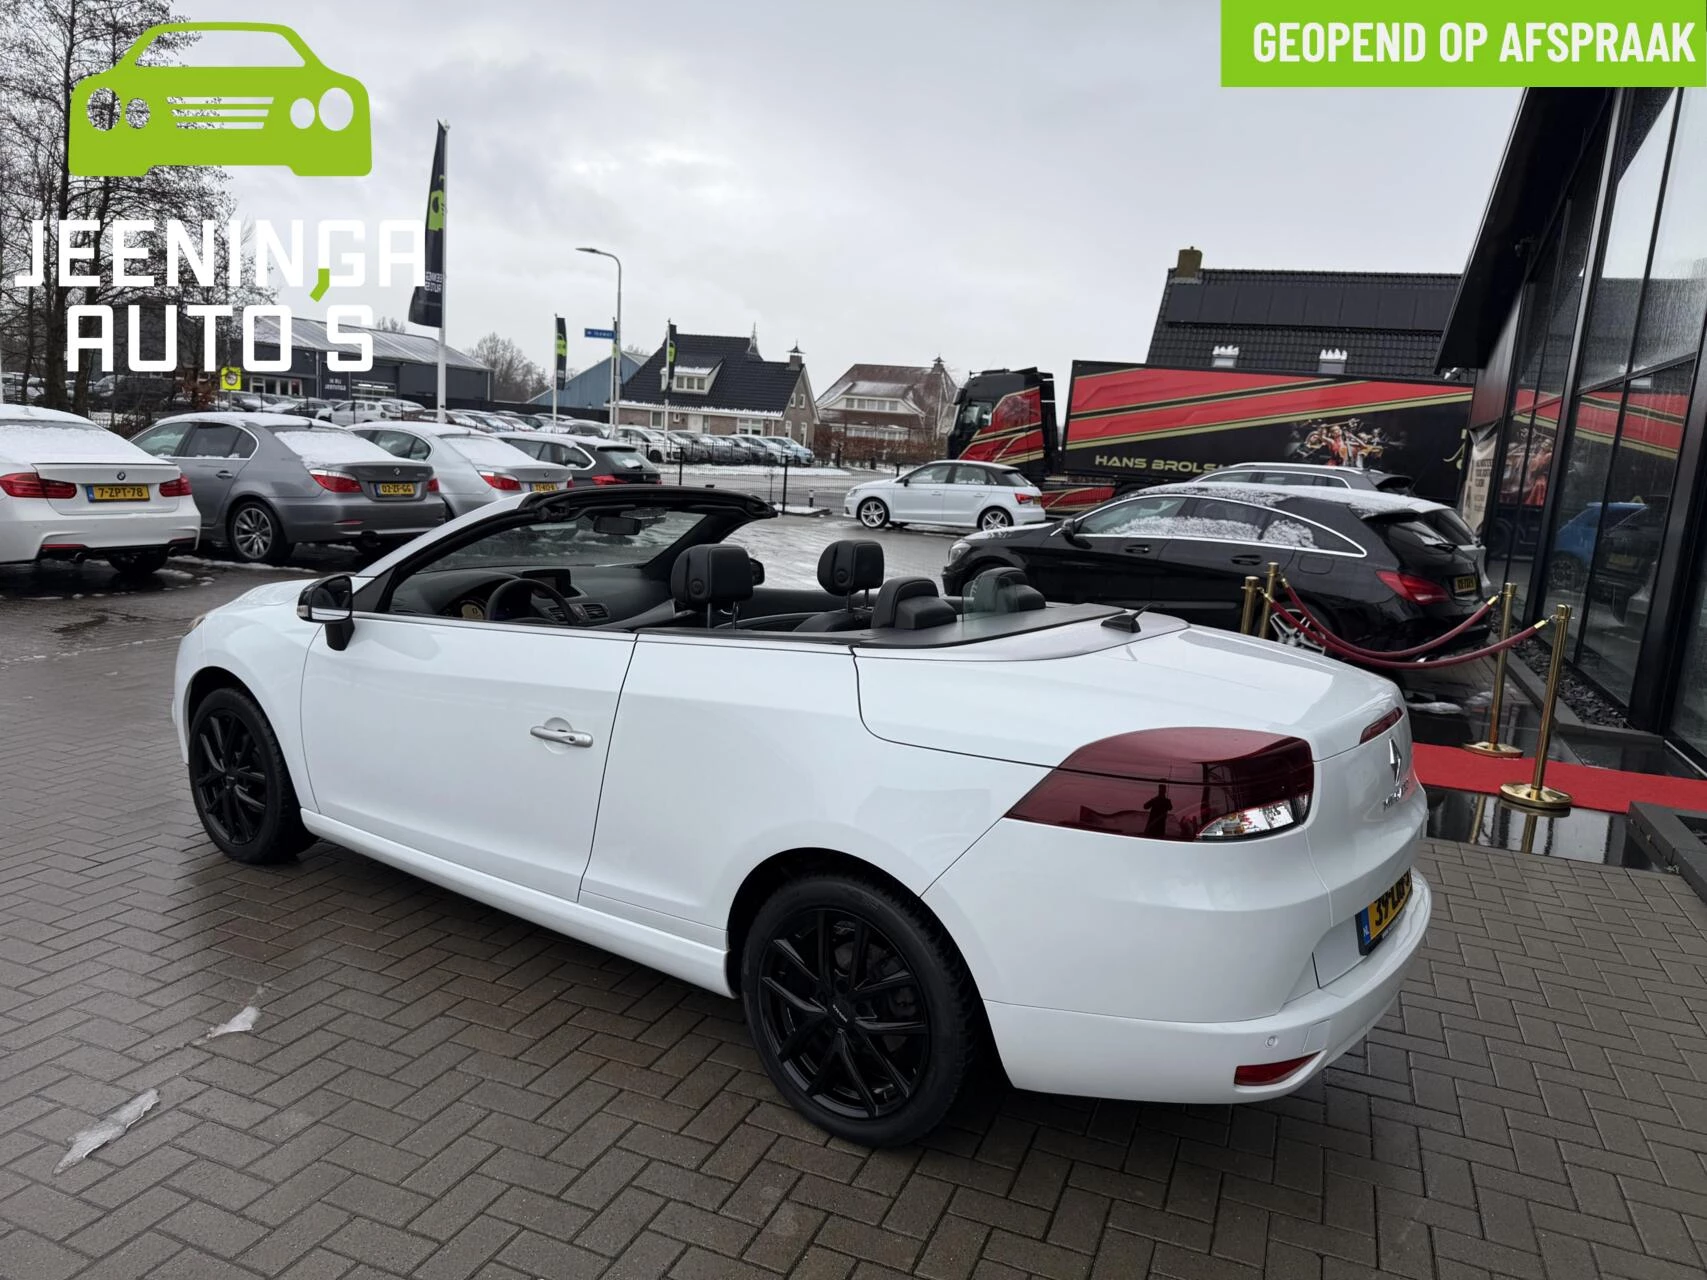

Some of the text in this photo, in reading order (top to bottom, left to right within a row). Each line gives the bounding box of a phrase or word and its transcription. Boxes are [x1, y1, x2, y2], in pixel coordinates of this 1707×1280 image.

[1094, 455, 1221, 474] HANS BROLS
[98, 487, 143, 497] 7-ZPT-78
